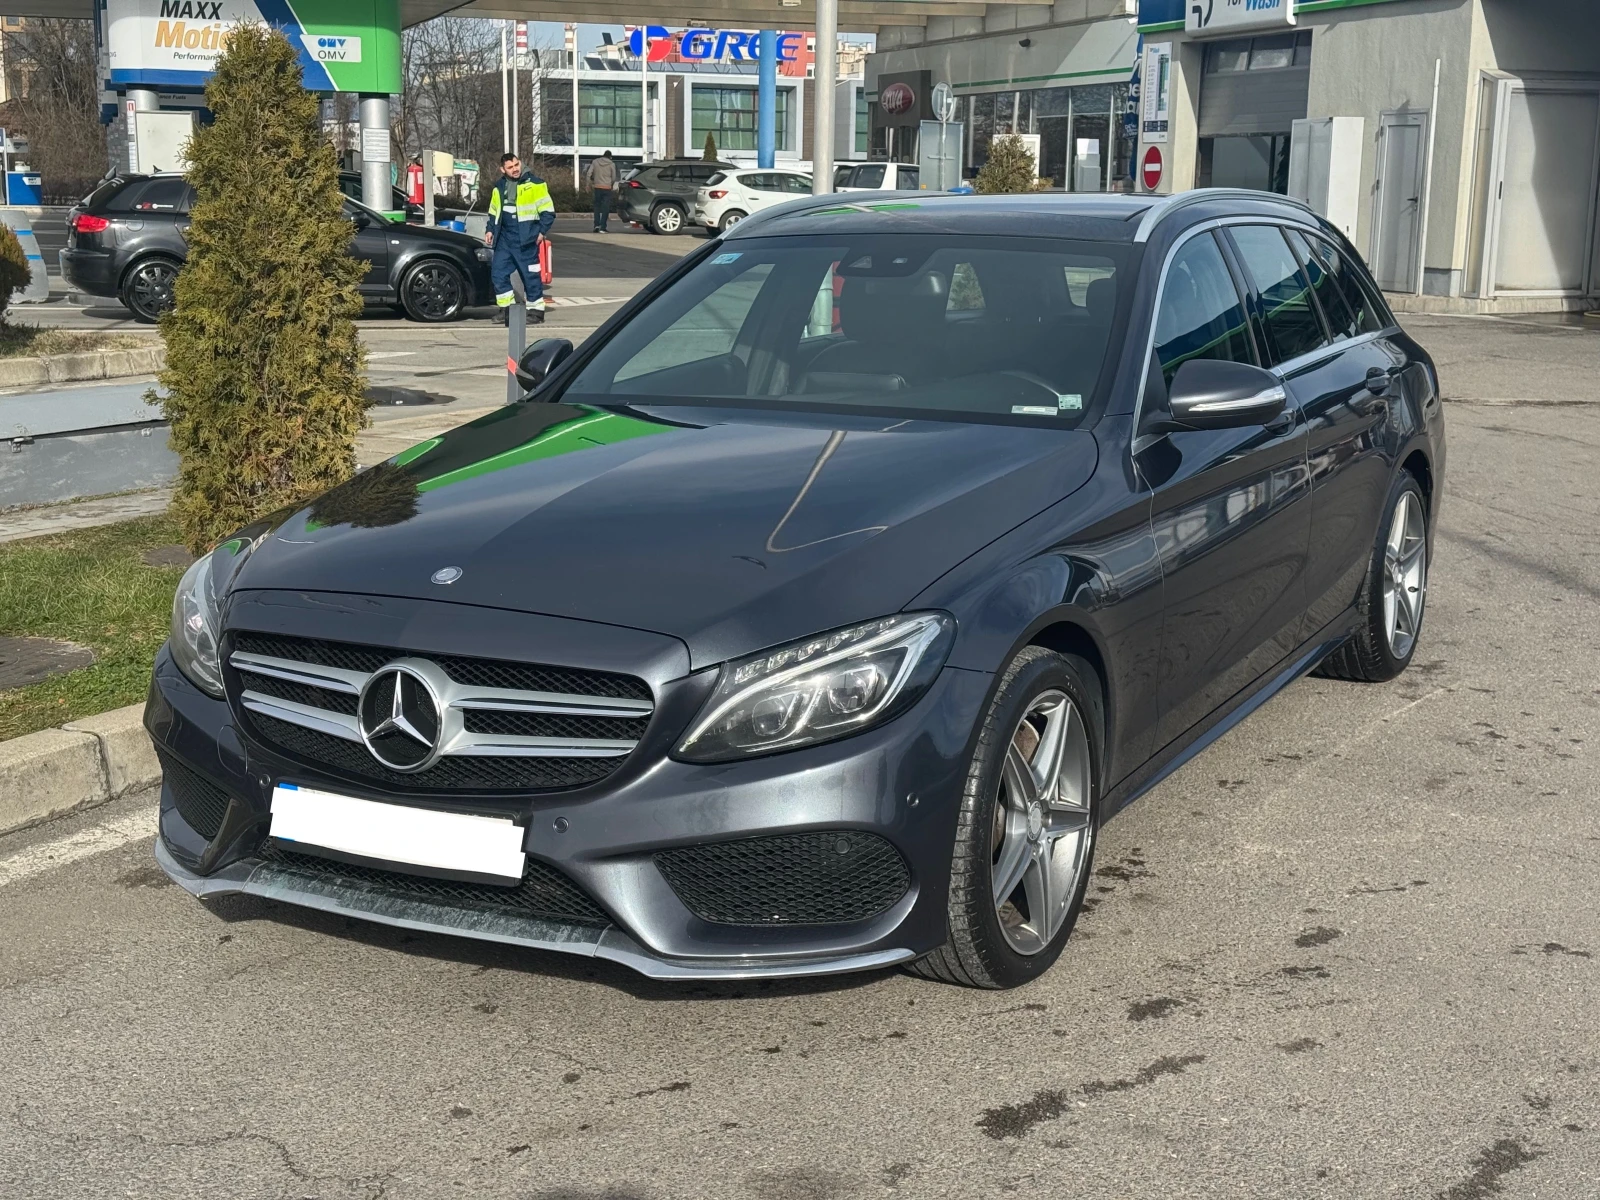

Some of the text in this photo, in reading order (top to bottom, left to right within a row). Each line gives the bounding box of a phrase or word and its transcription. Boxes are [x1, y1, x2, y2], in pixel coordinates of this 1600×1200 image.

[160, 0, 223, 20] MAXX
[155, 20, 234, 50] Motio
[173, 51, 218, 61] Performan
[318, 50, 346, 60] OMV
